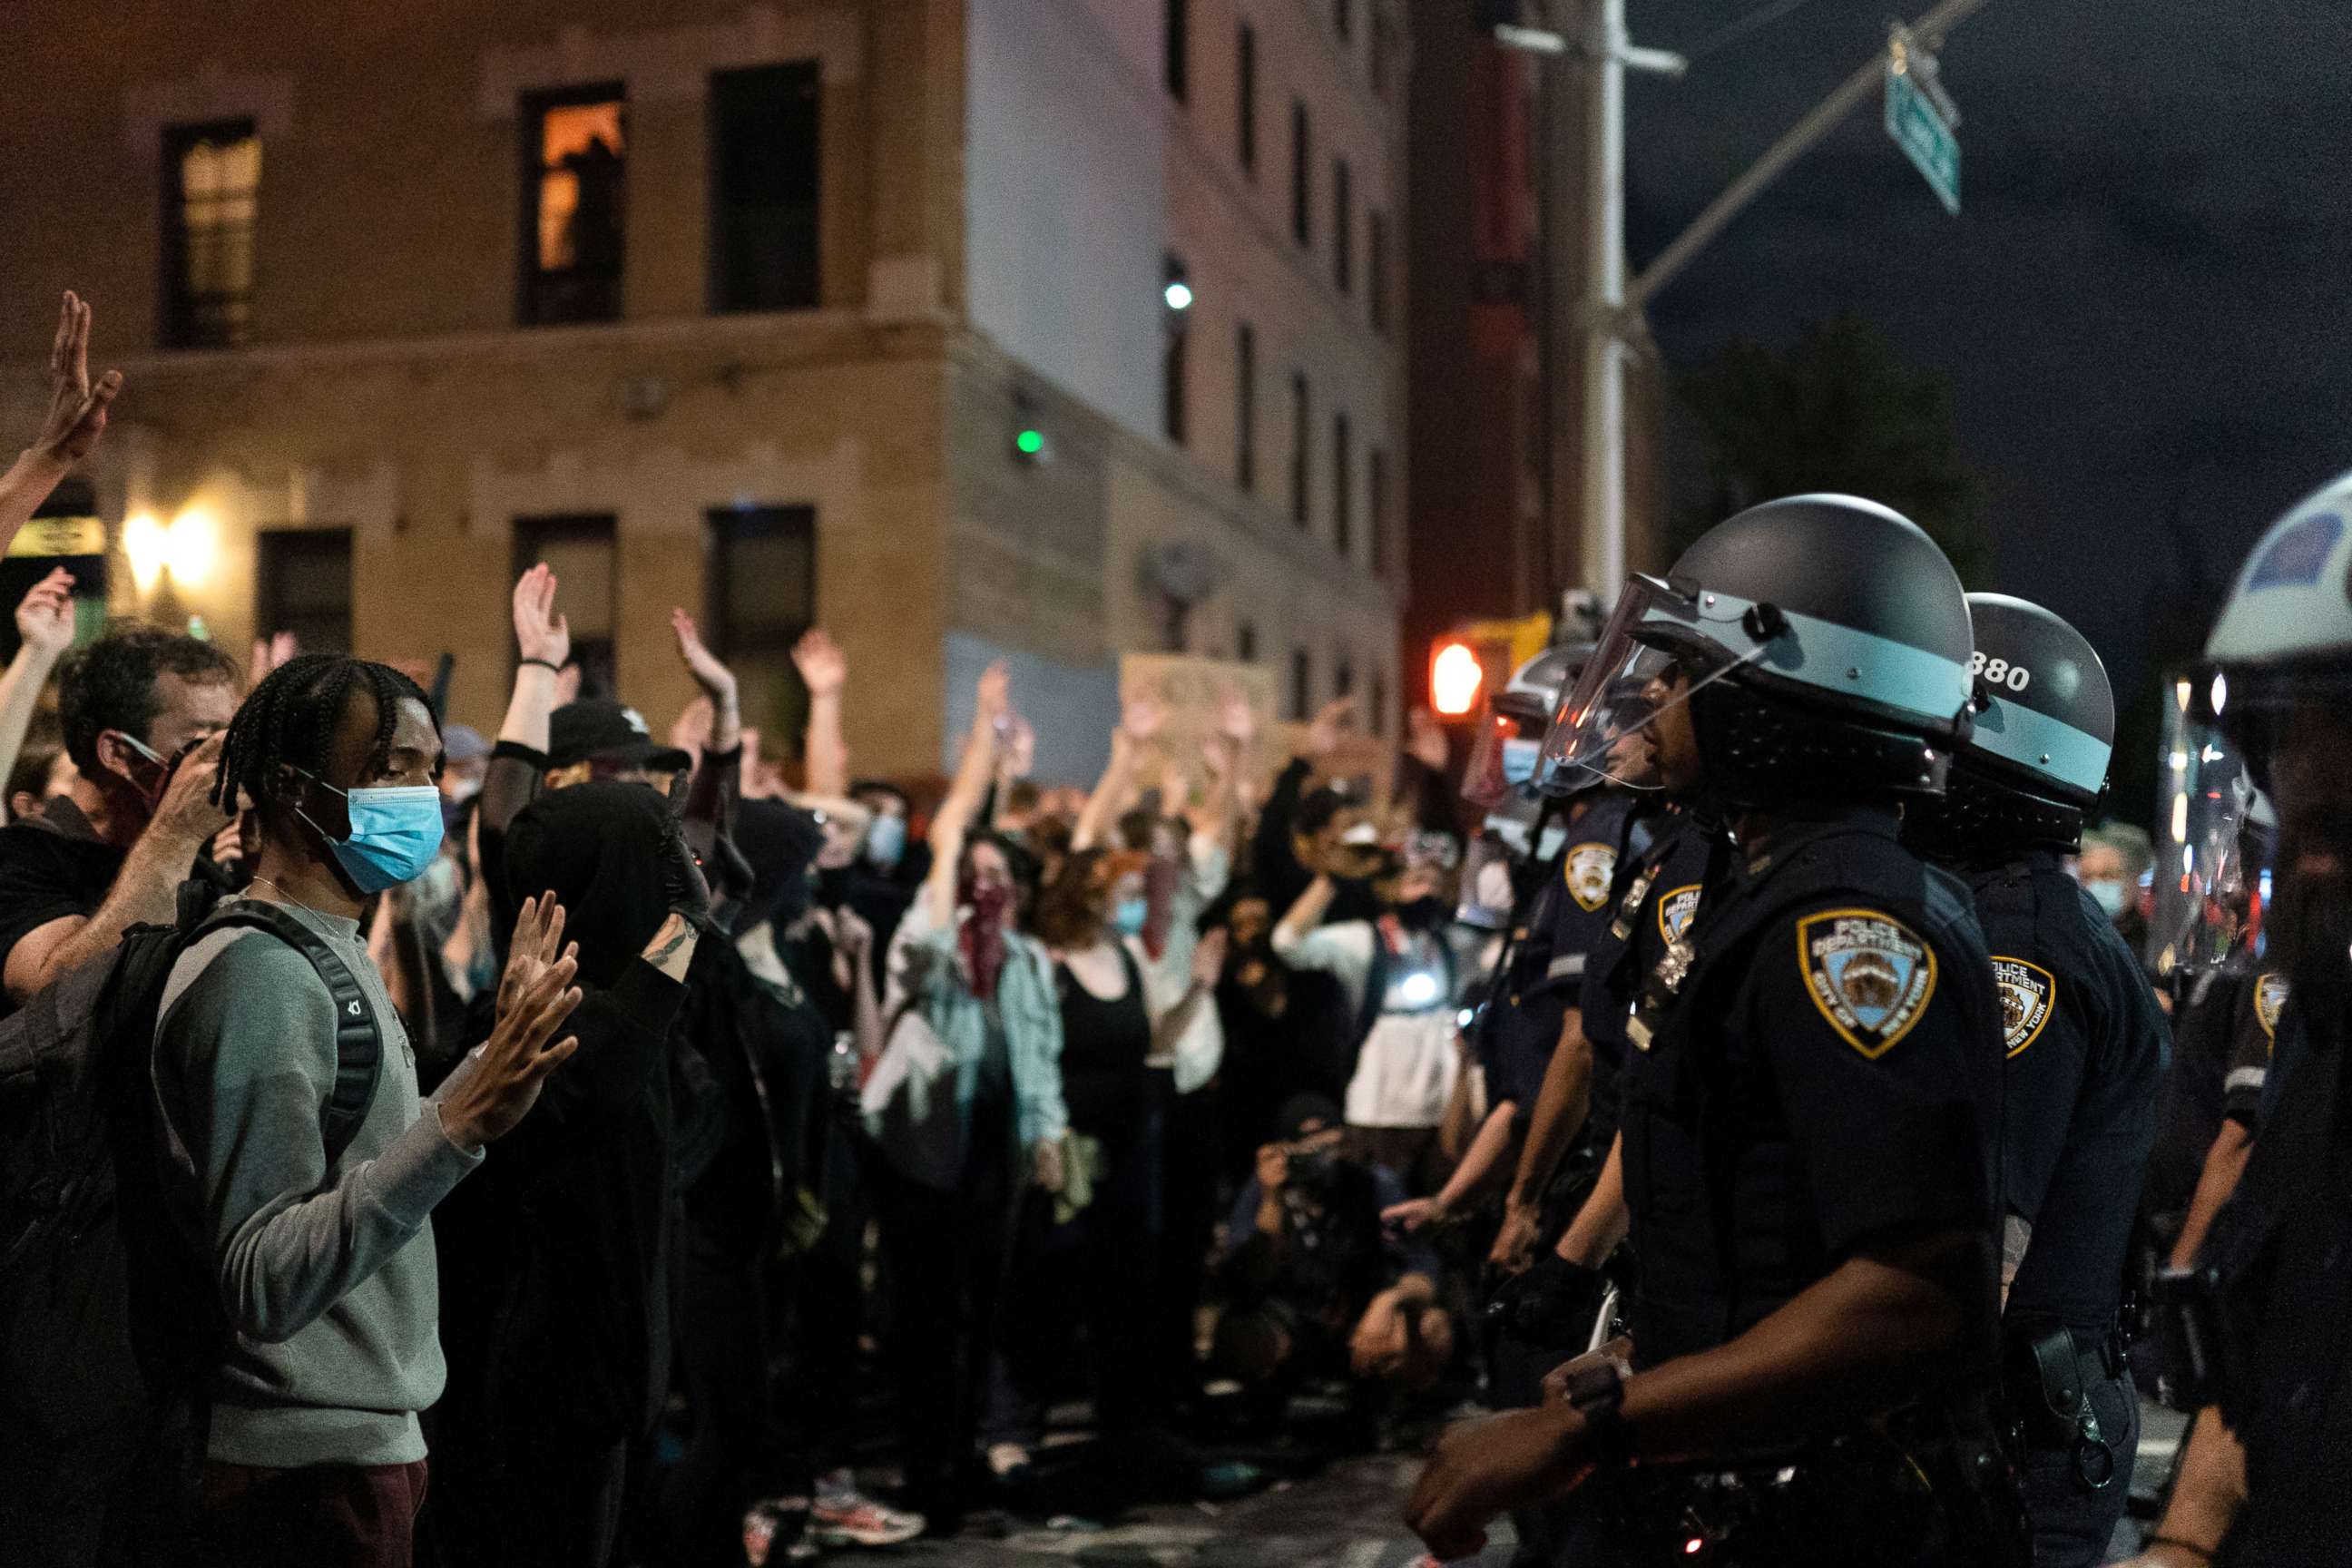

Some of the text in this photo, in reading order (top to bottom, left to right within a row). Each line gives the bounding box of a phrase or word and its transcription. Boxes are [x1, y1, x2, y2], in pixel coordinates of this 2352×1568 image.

[1834, 919, 1900, 939] POLICE
[1812, 933, 1923, 959] DEPARTMENT
[1992, 962, 2028, 978] OLICE
[1995, 971, 2045, 995] RTMENT
[1813, 971, 1858, 1029] CITY OF
[1880, 968, 1929, 1037] NEW YORK
[2006, 1002, 2047, 1049] NEW YORK
